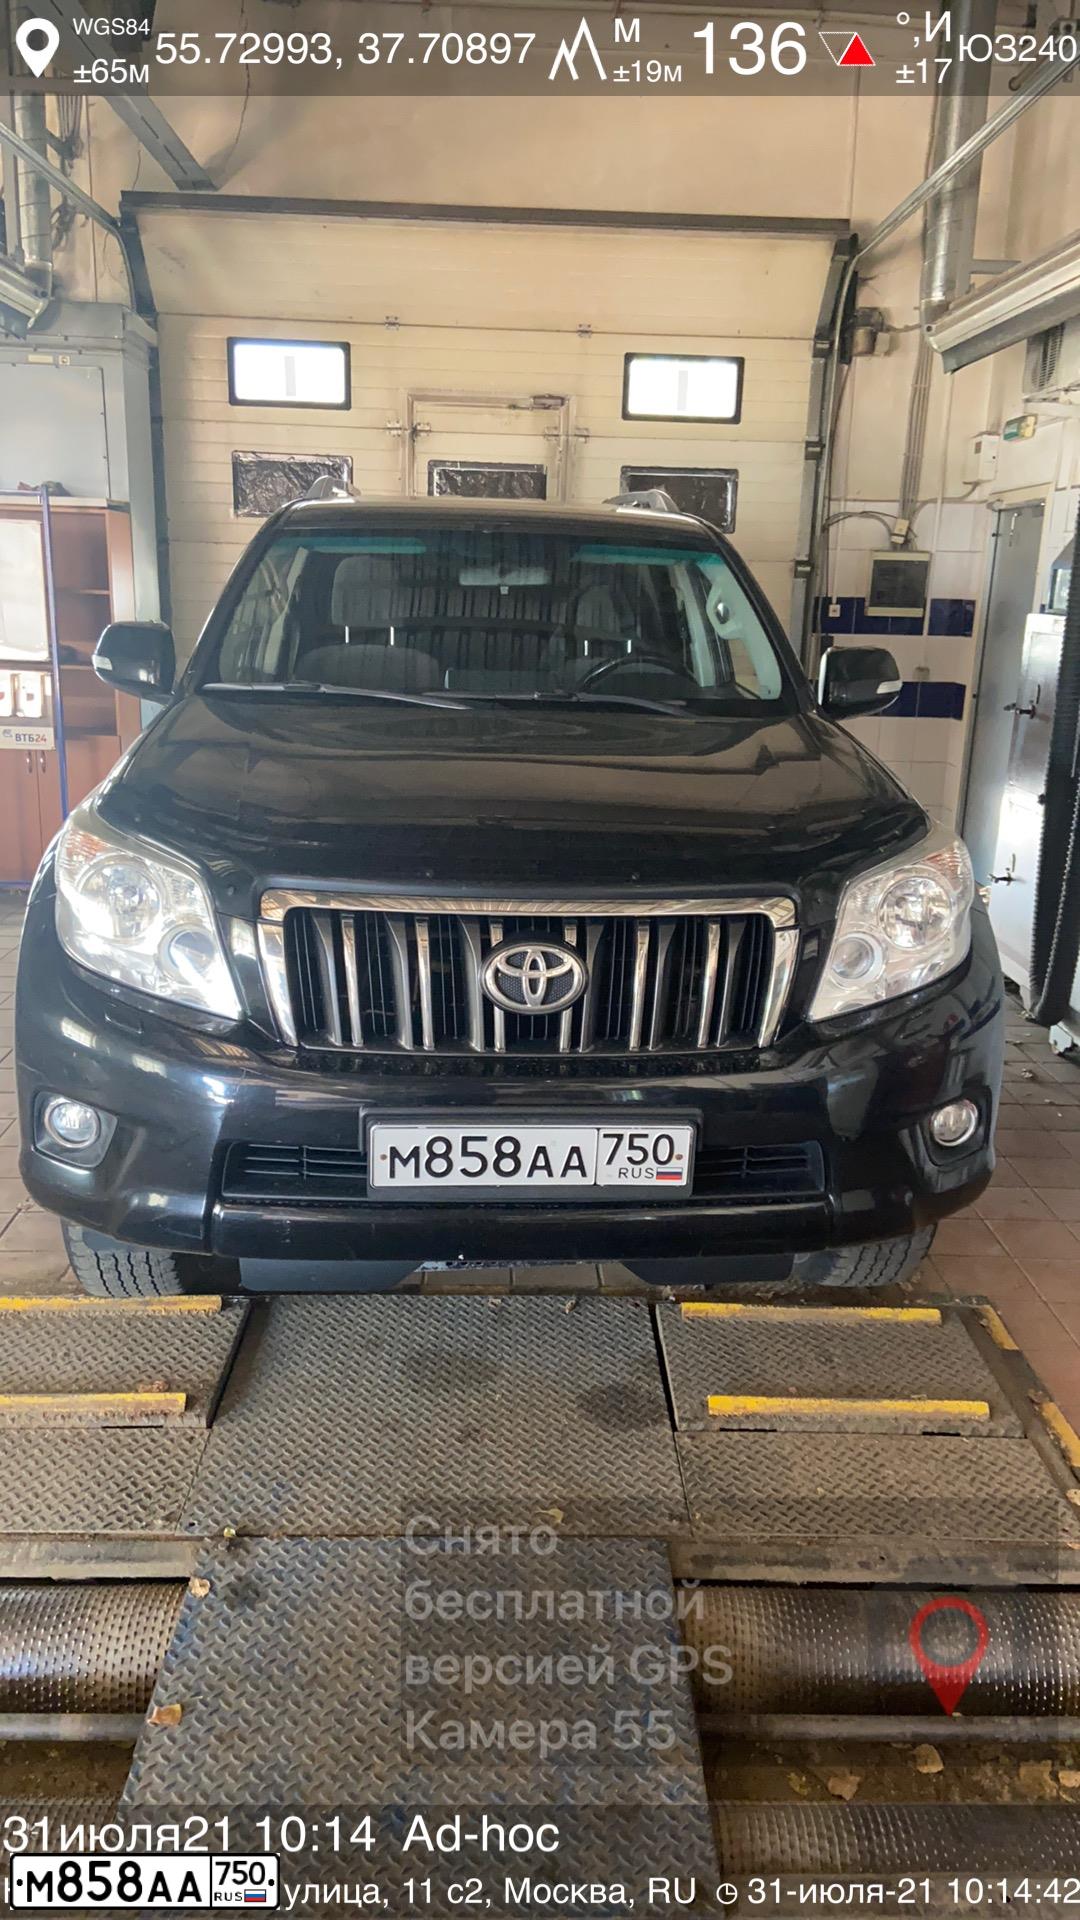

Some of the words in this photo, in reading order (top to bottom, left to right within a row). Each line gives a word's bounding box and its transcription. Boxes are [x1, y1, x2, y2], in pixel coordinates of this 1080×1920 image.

[15, 733, 47, 743] ВТБ24
[602, 1133, 675, 1166] 750
[618, 1167, 654, 1179] RUS
